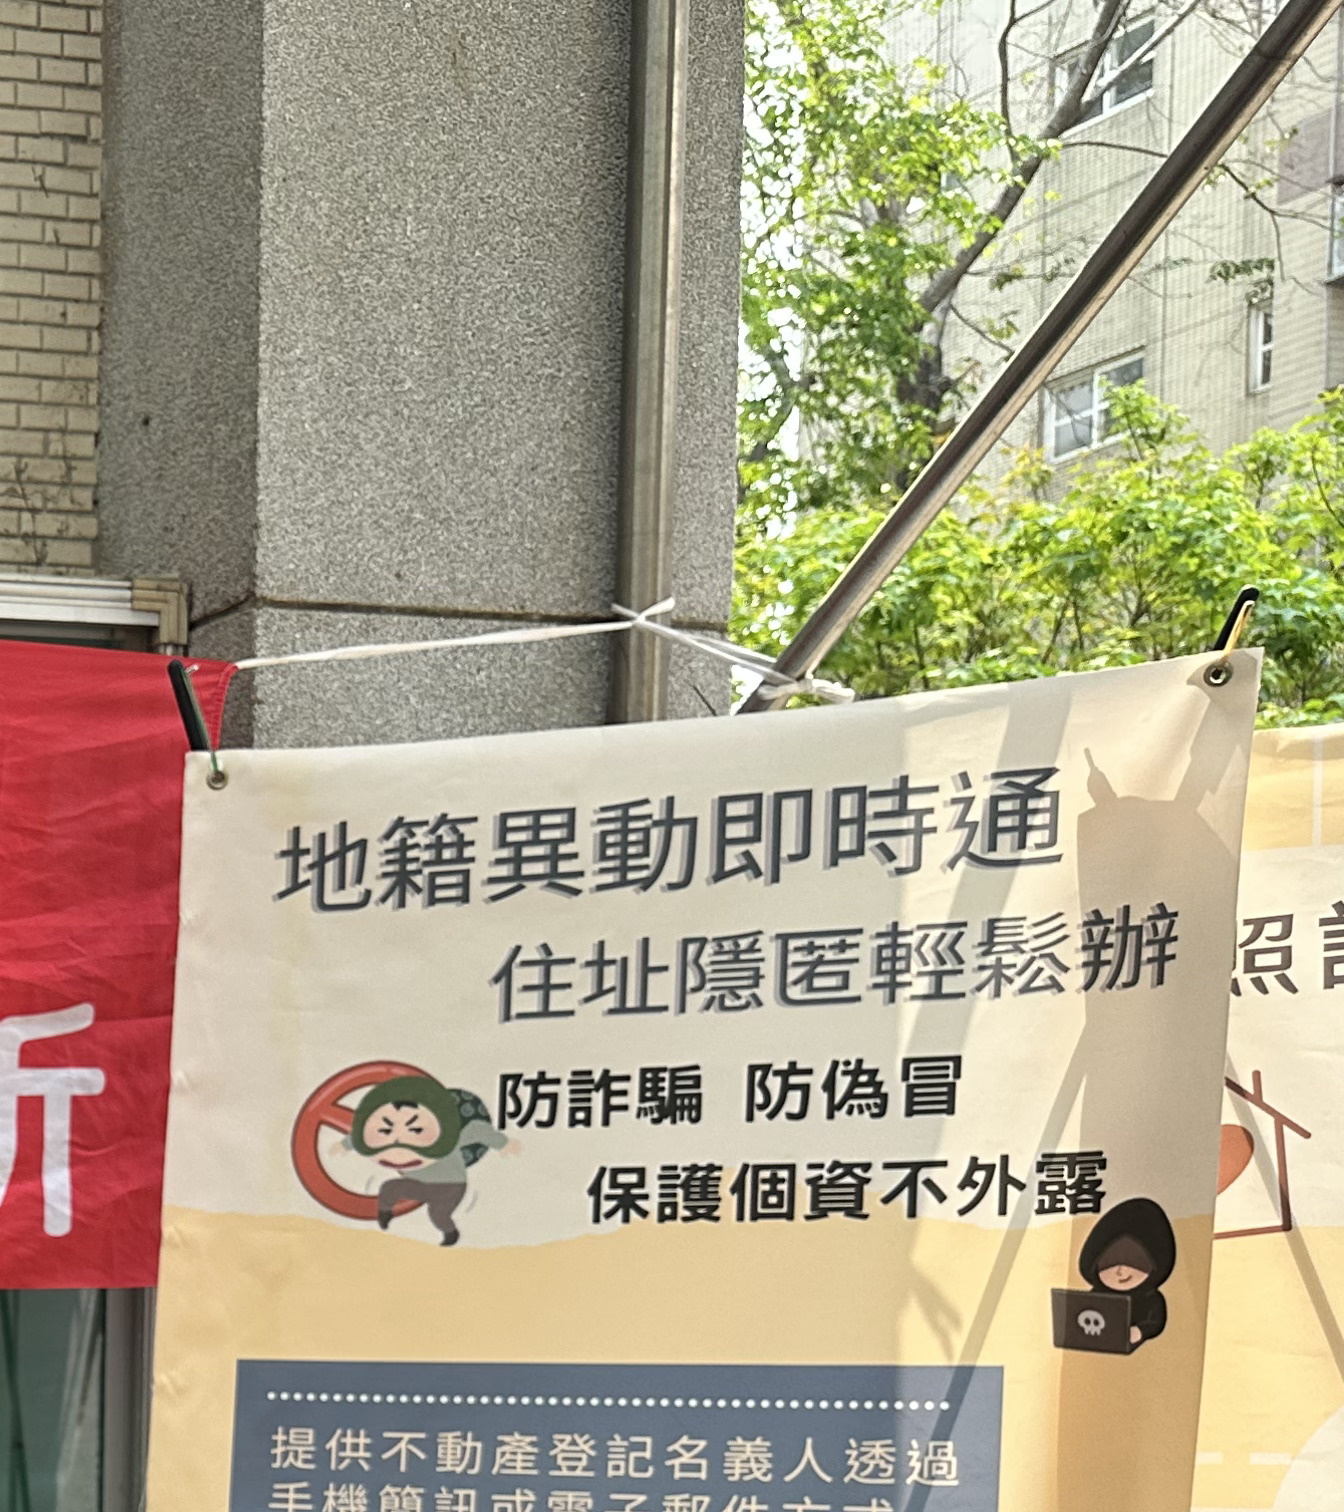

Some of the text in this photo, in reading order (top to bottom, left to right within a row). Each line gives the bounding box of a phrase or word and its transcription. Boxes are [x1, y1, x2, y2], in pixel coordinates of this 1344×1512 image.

[271, 765, 1063, 913] 地籍異動即時通
[488, 901, 1179, 1024] 住址隱匿輕鬆辦
[497, 1055, 962, 1131] 防詐騙 防偽冒
[587, 1149, 1108, 1225] 保護個資不外露
[269, 1425, 959, 1486] 提供不動產登記名義人透過
